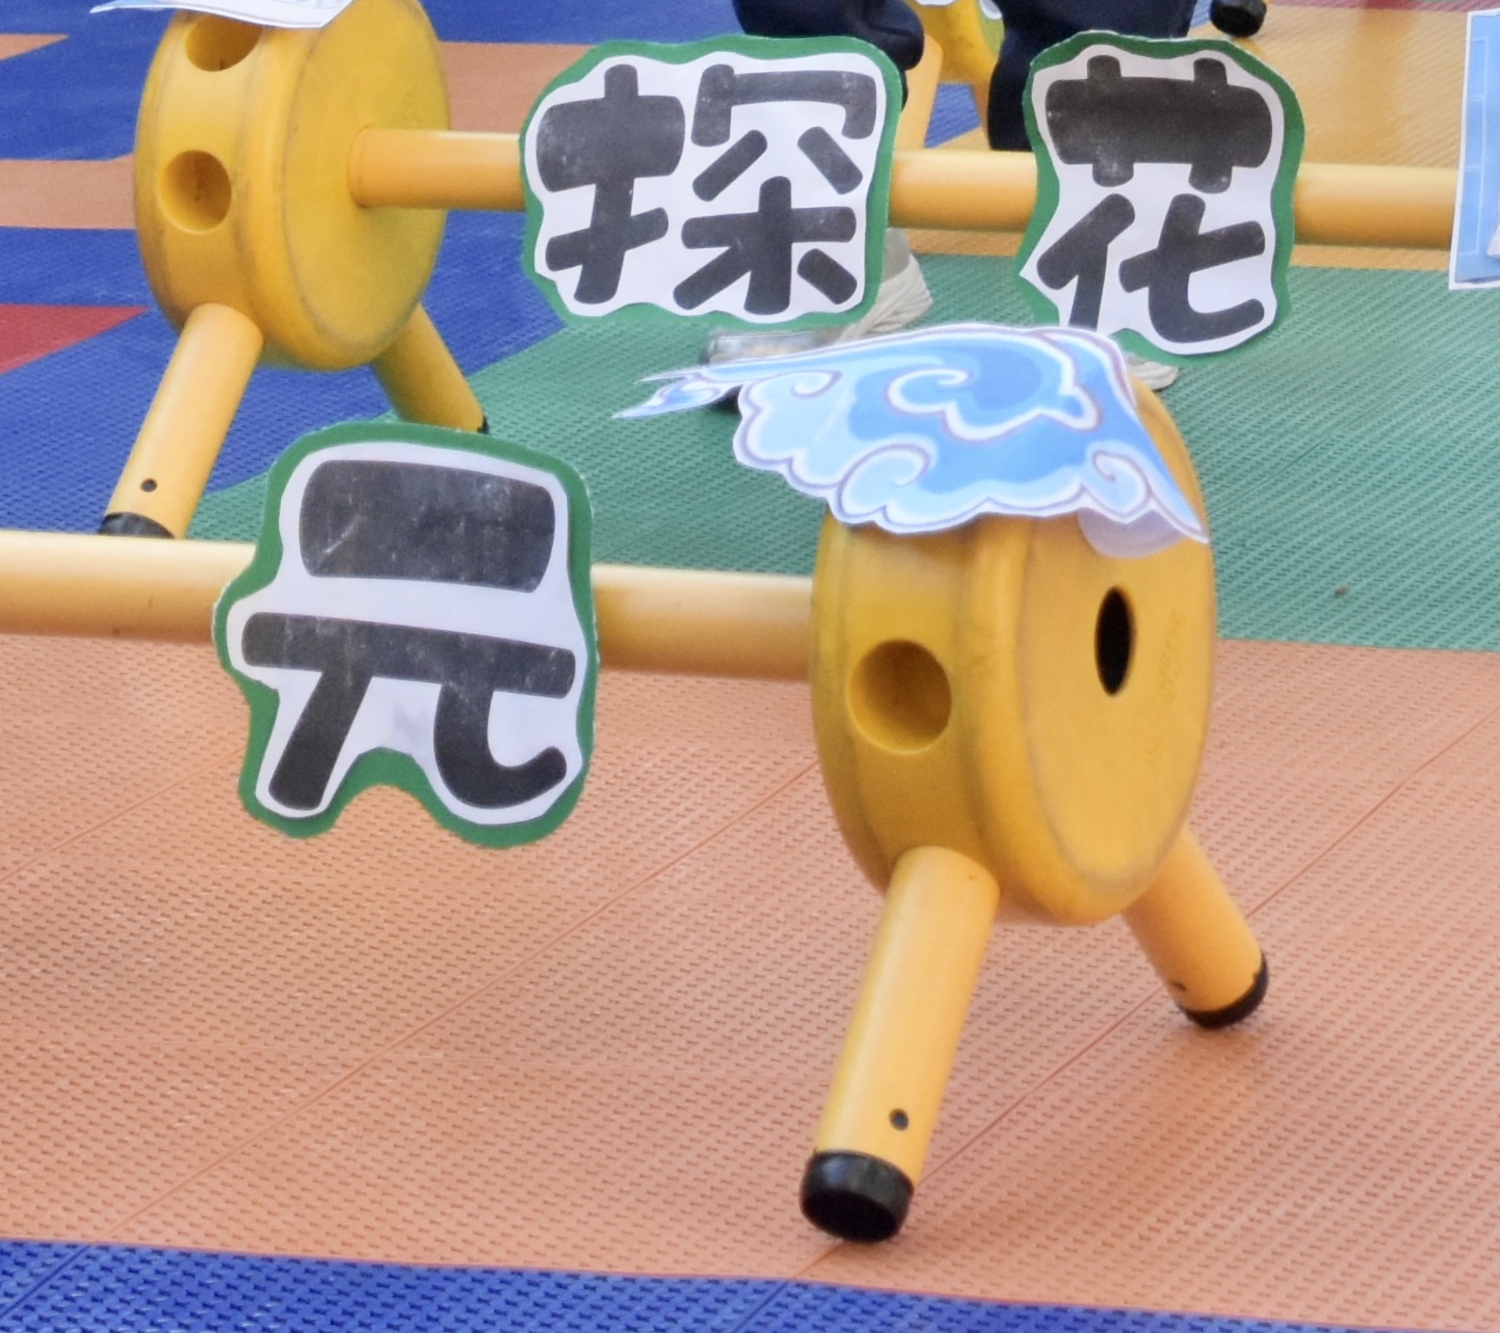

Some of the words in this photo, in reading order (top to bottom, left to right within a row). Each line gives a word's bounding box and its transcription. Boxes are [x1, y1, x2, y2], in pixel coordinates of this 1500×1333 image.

[535, 63, 877, 316] 探
[1038, 54, 1284, 336] 花
[242, 459, 576, 815] 元
